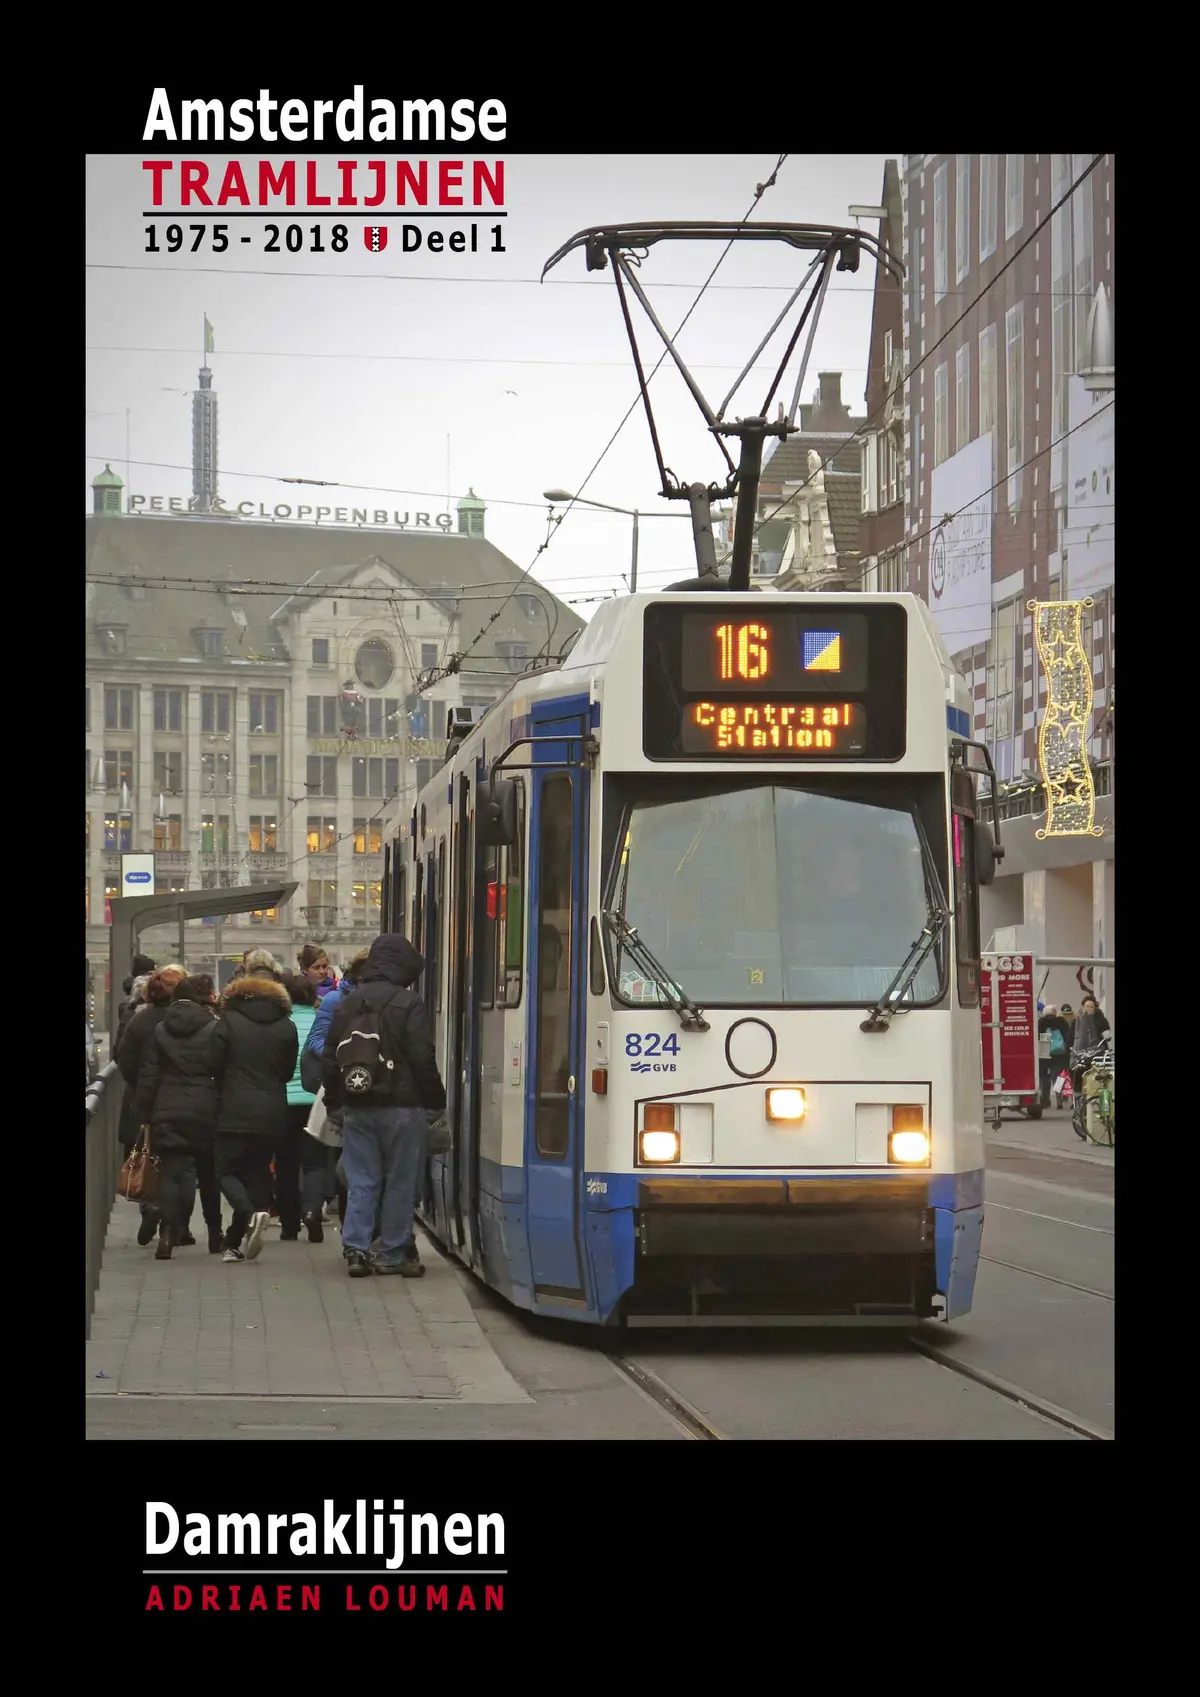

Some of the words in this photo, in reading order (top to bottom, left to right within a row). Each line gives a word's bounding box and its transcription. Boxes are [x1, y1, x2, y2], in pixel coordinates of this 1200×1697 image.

[237, 501, 454, 528] CLOPPENBURG
[715, 624, 769, 679] 16
[695, 702, 851, 726] Centraal
[717, 724, 833, 748] Station
[981, 956, 1024, 972] OGS
[625, 1033, 681, 1057] 824
[653, 1063, 677, 1072] GVB
